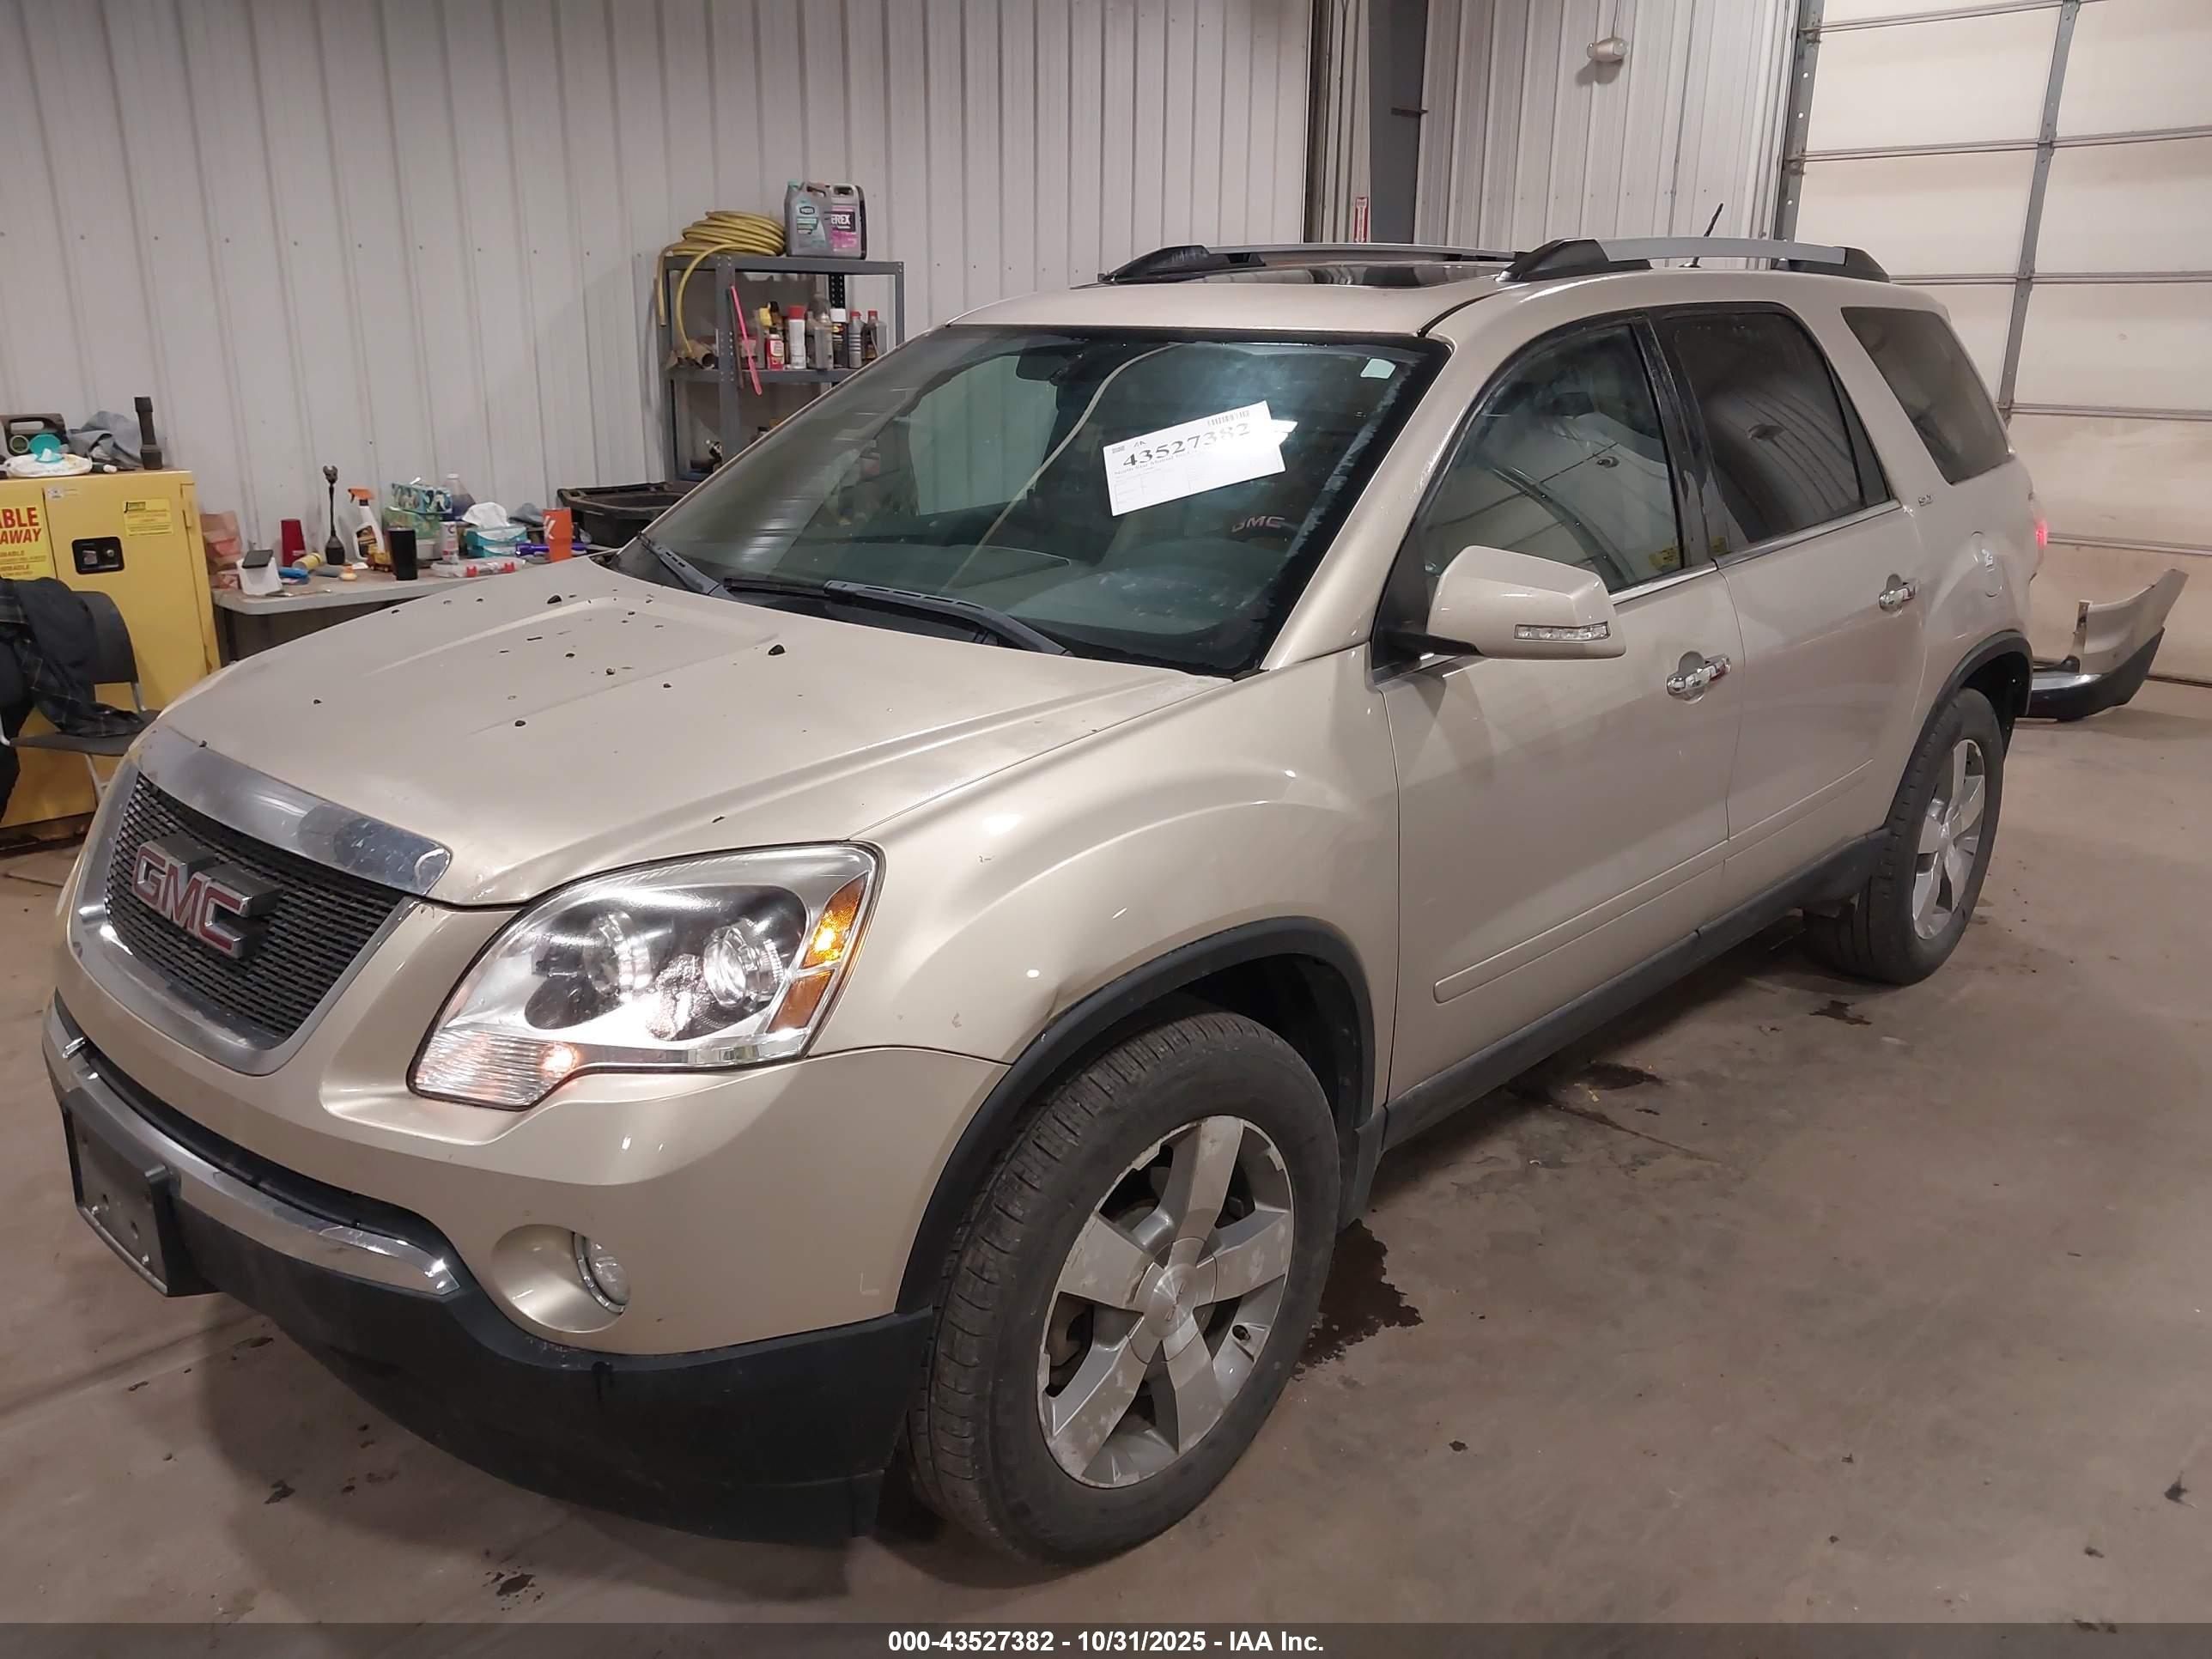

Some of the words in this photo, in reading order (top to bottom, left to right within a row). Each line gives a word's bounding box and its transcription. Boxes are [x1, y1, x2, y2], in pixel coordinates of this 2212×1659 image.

[1122, 423, 1251, 466] 43527382
[0, 507, 39, 528] BLE
[0, 528, 41, 544] AWAY
[132, 841, 252, 958] GMC
